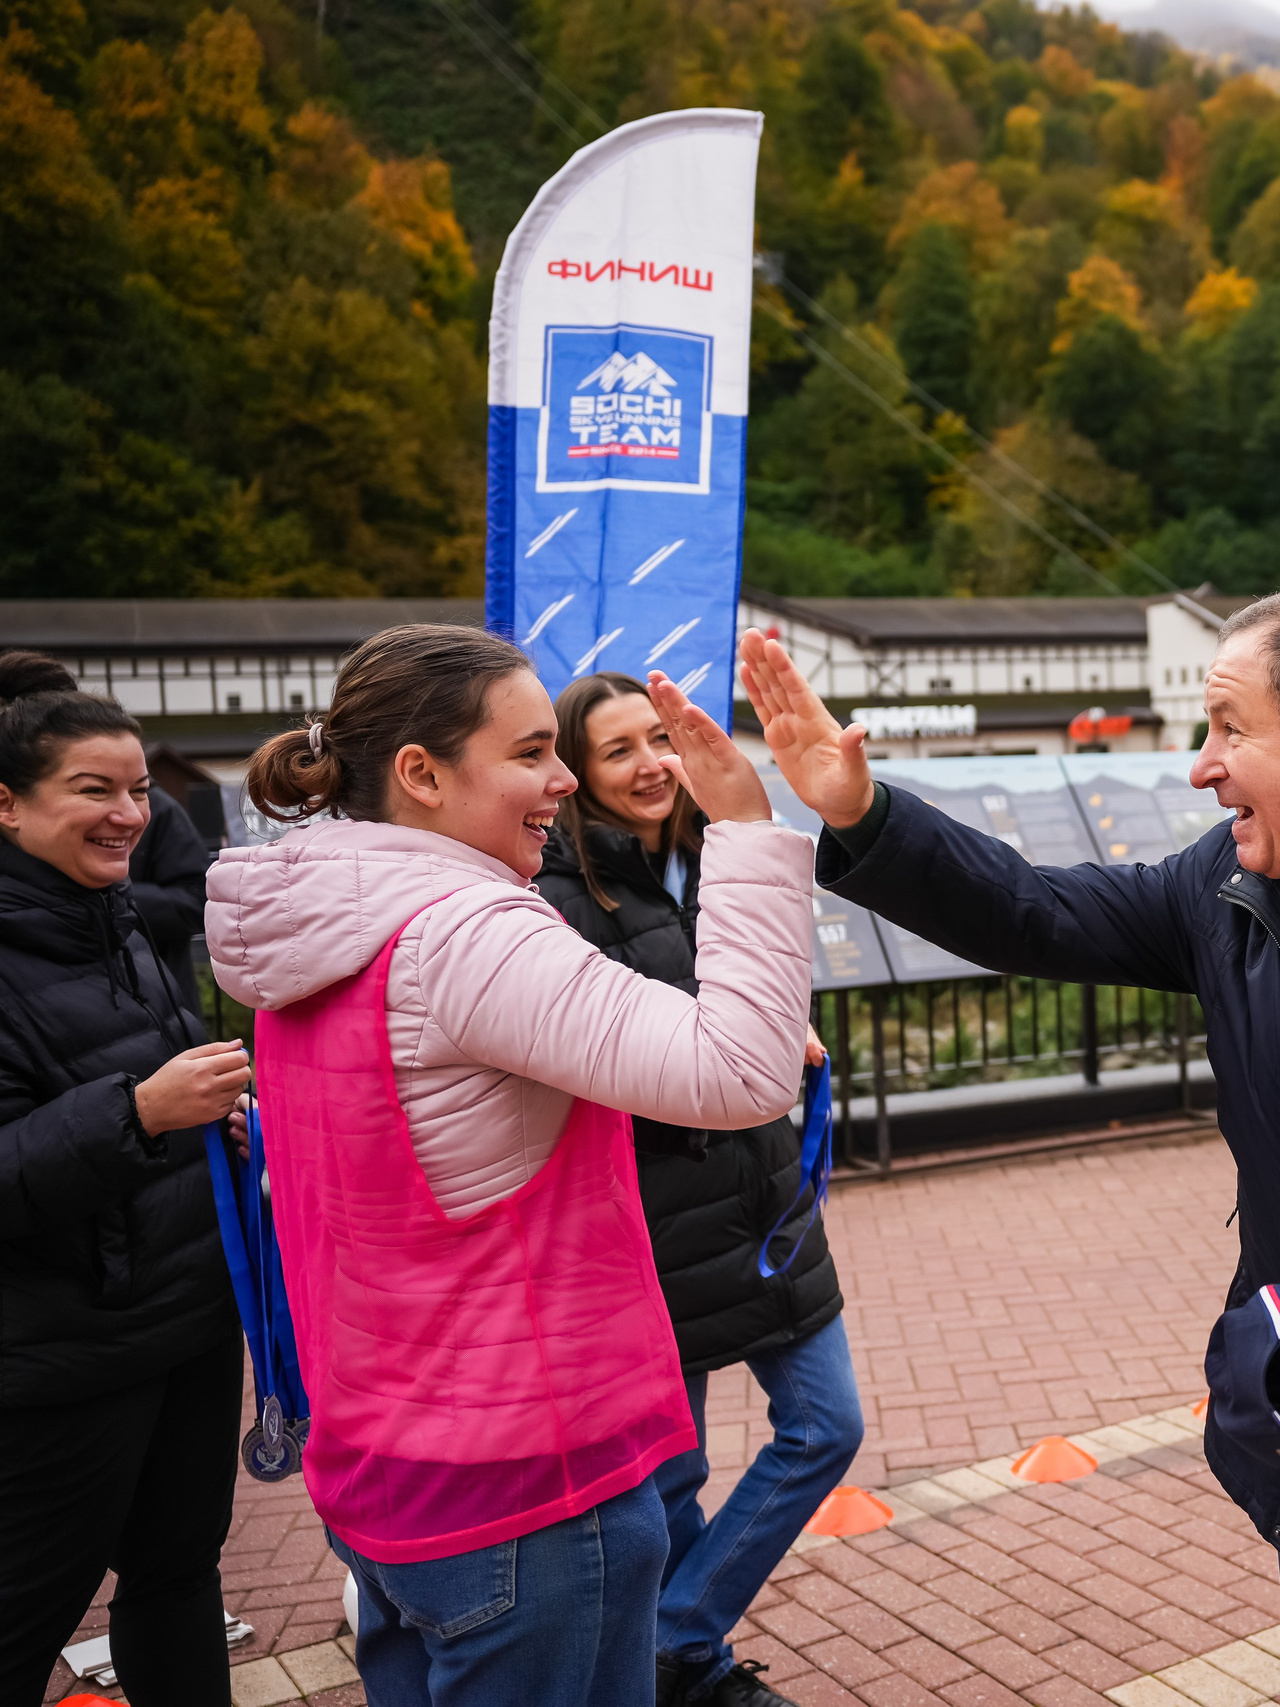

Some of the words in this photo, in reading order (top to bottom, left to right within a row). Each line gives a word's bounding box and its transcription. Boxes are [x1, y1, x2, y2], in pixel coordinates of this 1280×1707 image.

[548, 259, 713, 291] ФИНИШ
[570, 392, 682, 417] SOCHI
[569, 411, 682, 428] SKYRUNNING
[569, 422, 681, 447] TEAM
